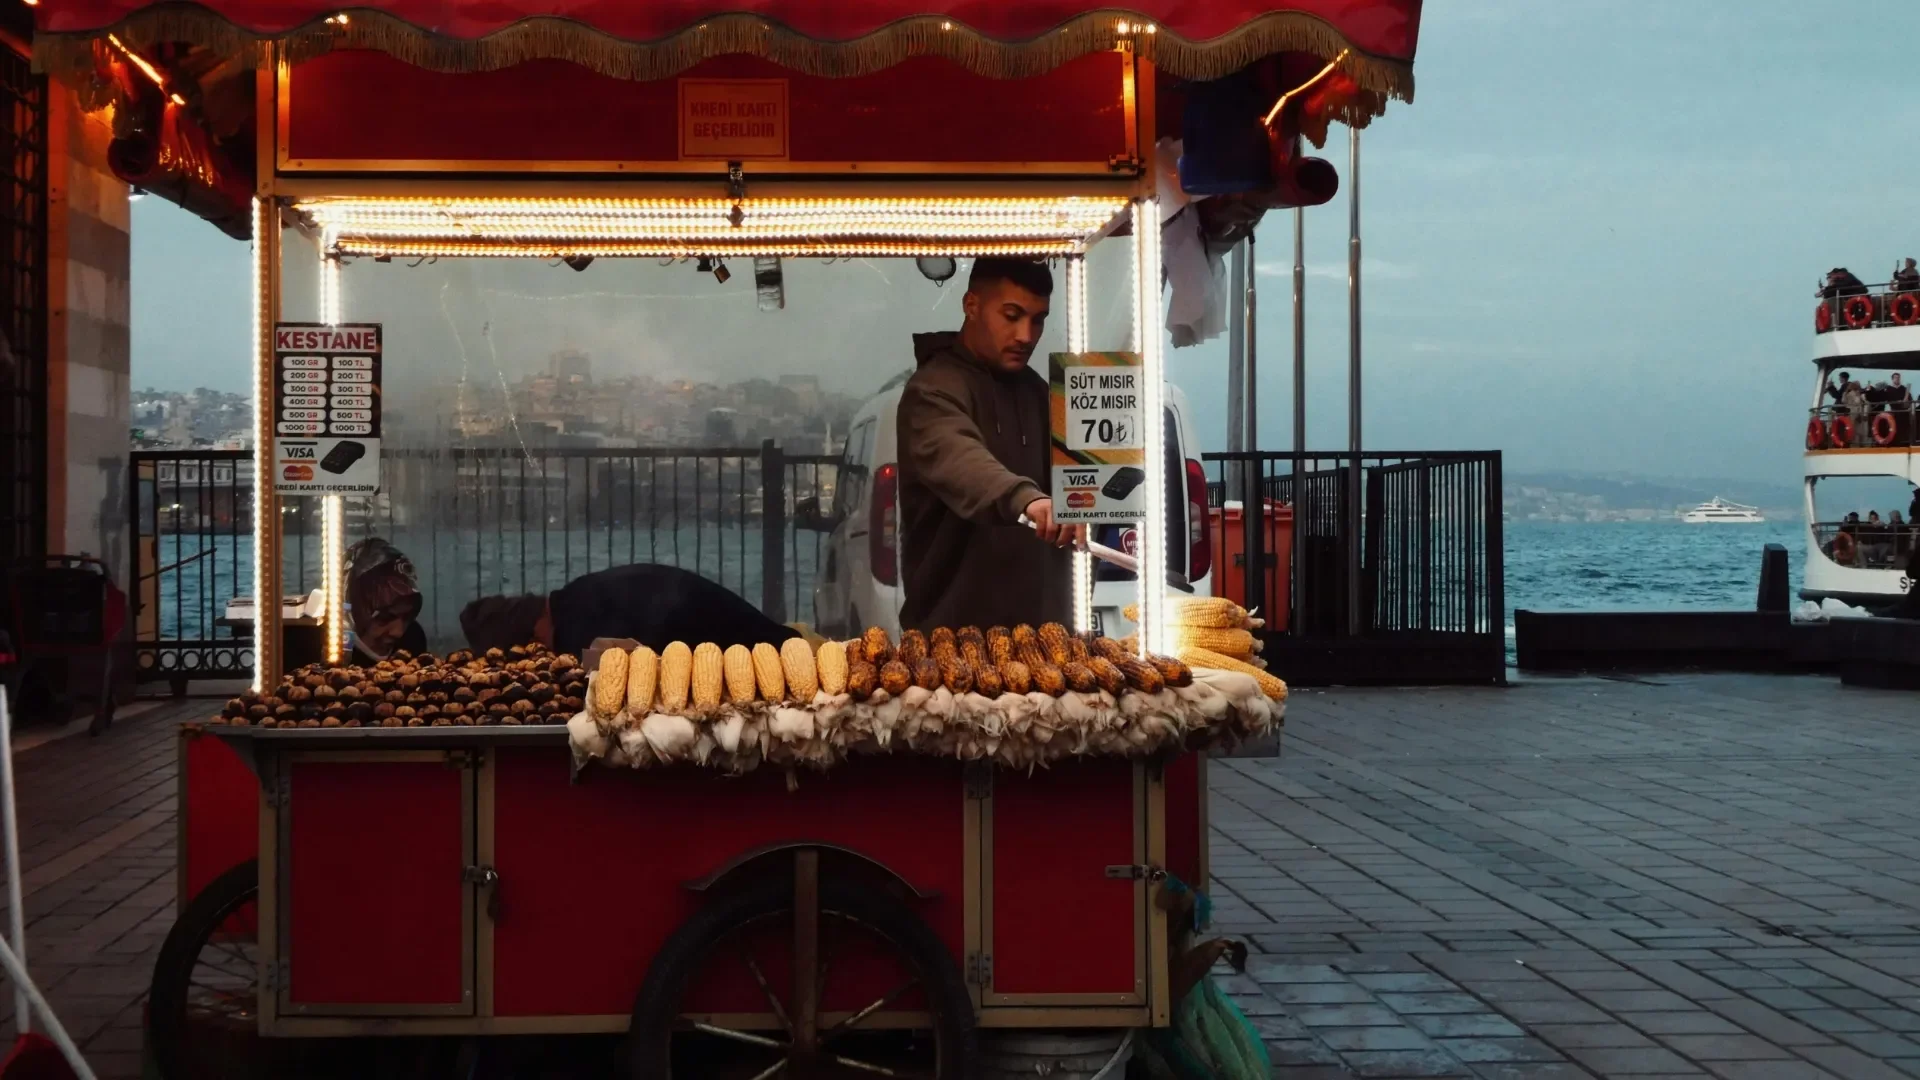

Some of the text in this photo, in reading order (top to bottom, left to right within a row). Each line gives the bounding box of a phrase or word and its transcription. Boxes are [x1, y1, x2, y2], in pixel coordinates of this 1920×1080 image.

[737, 101, 777, 117] KARTI
[276, 331, 376, 350] KESTANE
[307, 359, 319, 367] GR
[1070, 372, 1135, 389] SÜT MISIR
[1070, 392, 1137, 409] KÖZ MISIR
[285, 447, 315, 458] VISA
[1068, 475, 1096, 486] VISA
[326, 484, 374, 492] GEÇERLİDİR
